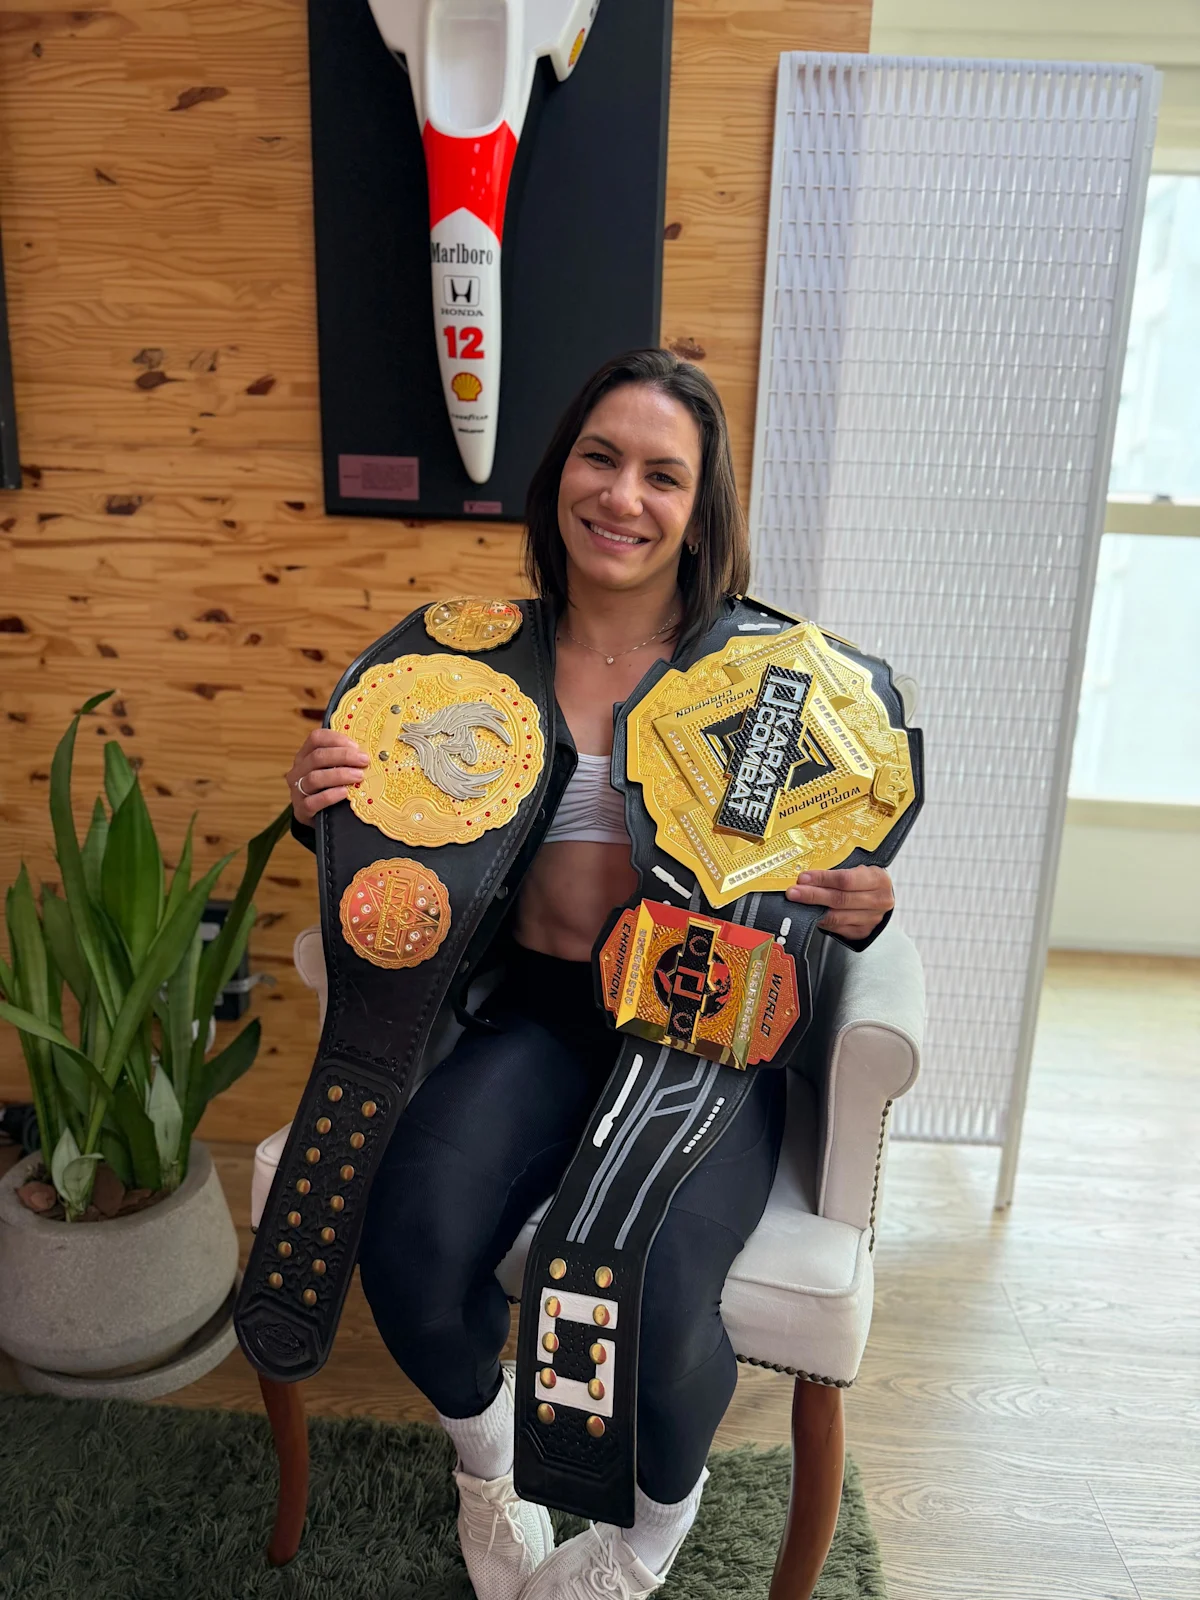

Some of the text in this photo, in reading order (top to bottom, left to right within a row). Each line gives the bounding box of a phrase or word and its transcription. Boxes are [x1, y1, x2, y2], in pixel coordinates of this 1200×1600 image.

[430, 242, 494, 265] Marlboro
[441, 308, 484, 317] HONDA
[443, 325, 485, 359] 12
[676, 689, 733, 718] CHAMPION
[715, 688, 754, 709] WORLD
[728, 707, 776, 816] COMBAT
[744, 710, 796, 820] KARATE
[779, 786, 838, 819] CHAMPION
[820, 786, 861, 810] WORLD
[609, 922, 631, 999] CHAMPION
[761, 973, 783, 1038] WORLD
